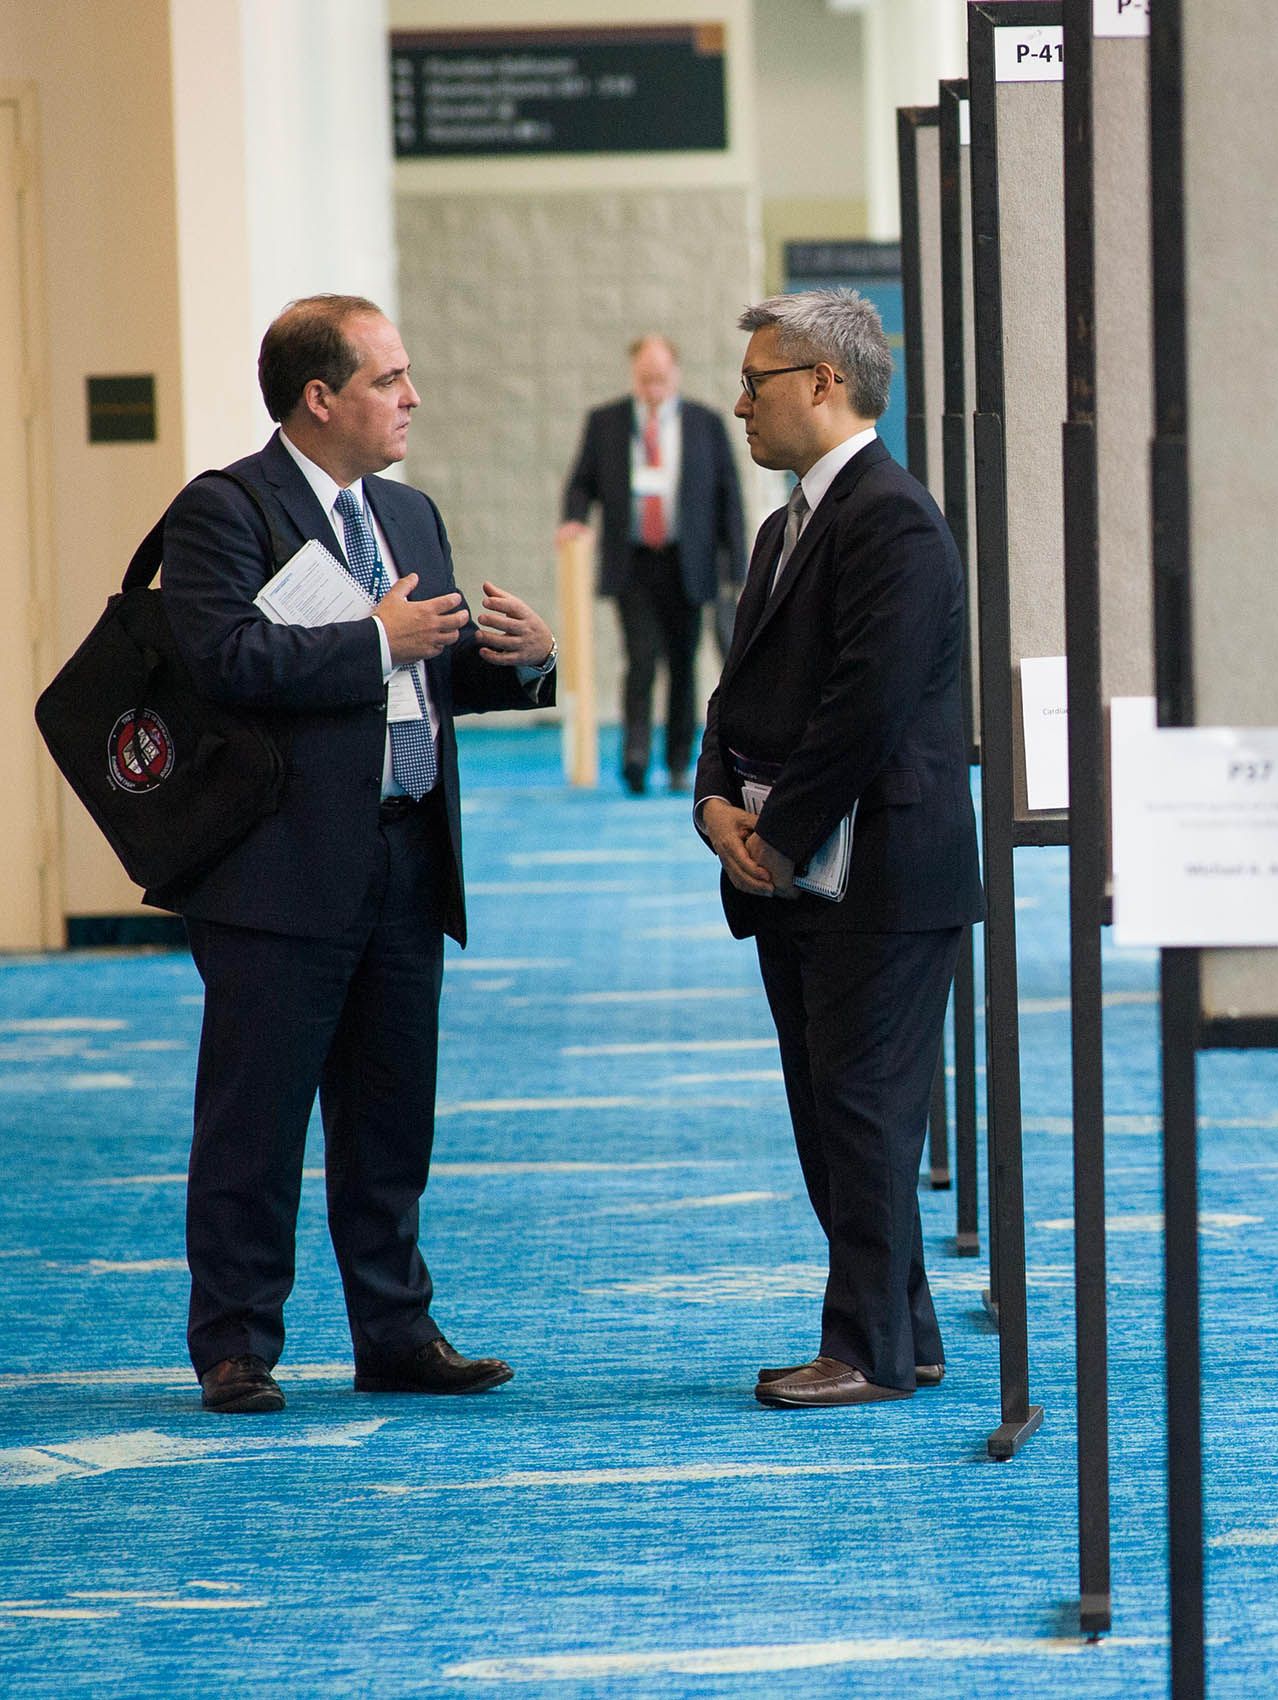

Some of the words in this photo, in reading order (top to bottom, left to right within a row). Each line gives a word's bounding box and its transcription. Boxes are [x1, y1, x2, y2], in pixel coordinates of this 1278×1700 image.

[1117, 0, 1151, 14] P-
[1016, 44, 1063, 63] P-41
[1042, 706, 1067, 716] Cardia
